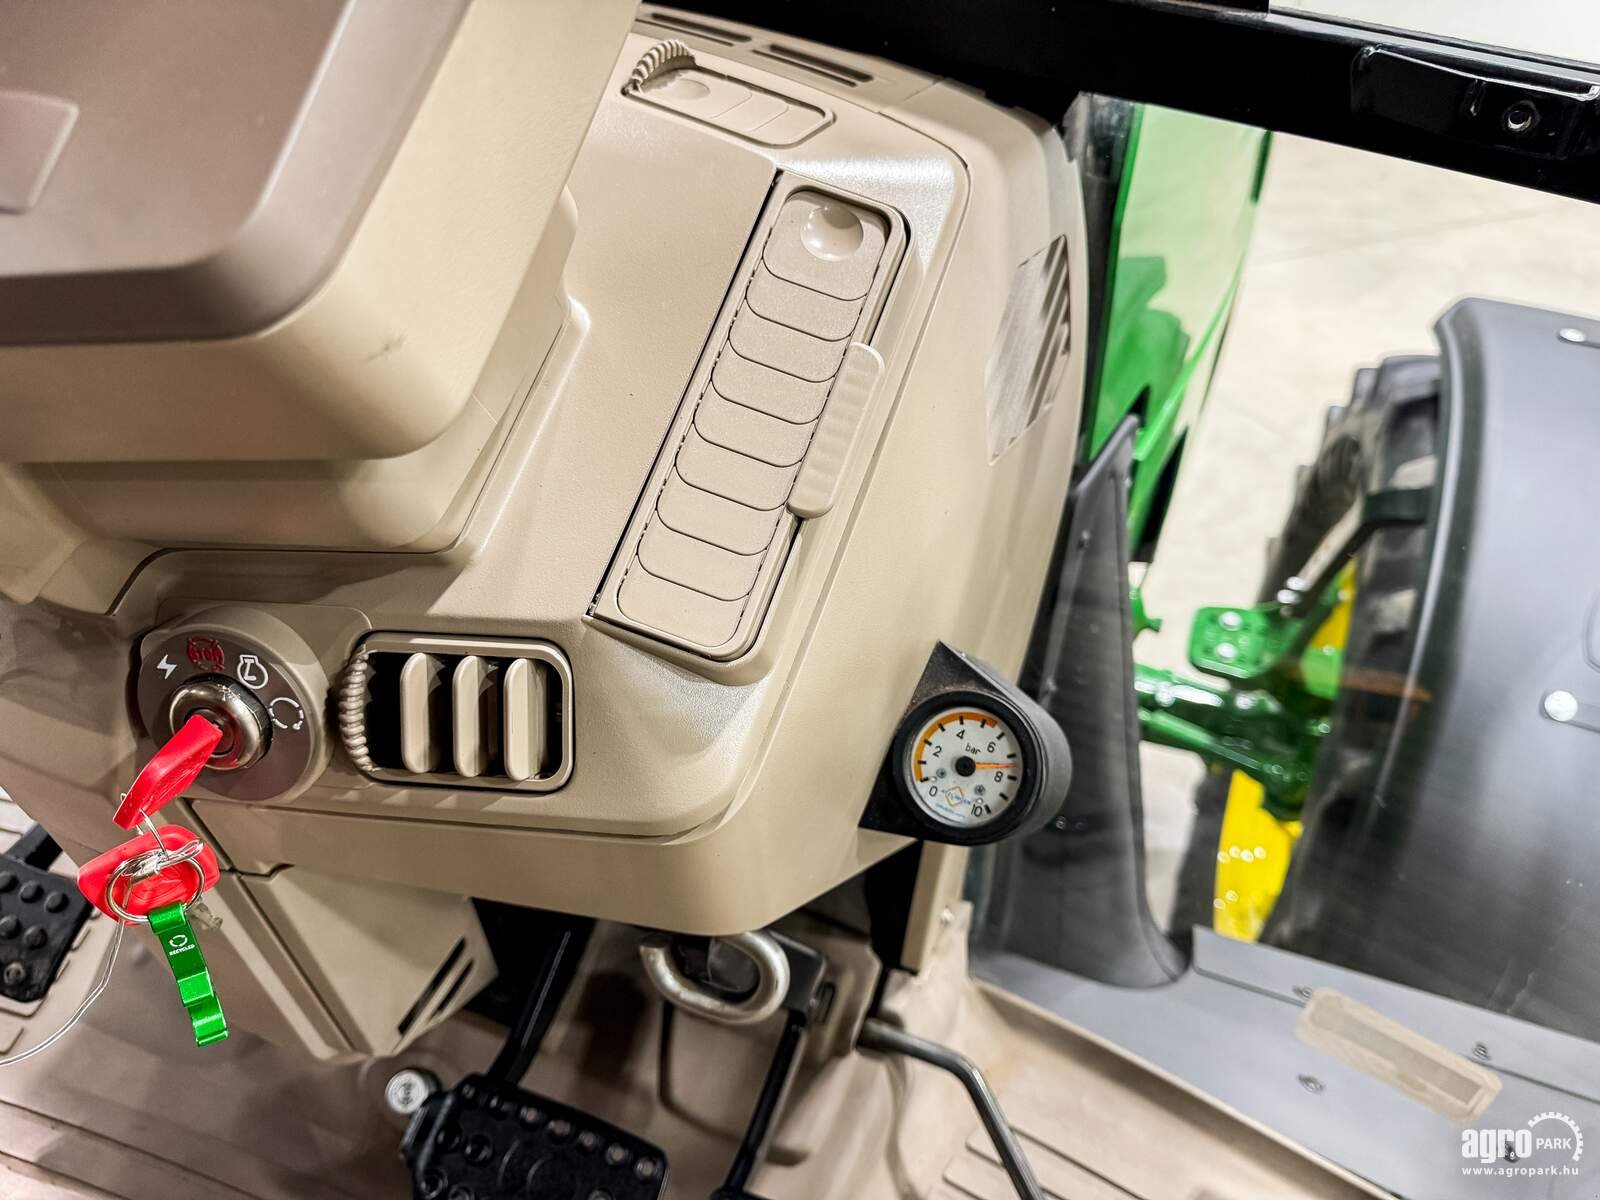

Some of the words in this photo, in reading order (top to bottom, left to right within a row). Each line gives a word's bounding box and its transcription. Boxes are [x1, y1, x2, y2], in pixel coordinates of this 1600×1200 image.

[956, 730, 965, 740] 4
[933, 746, 942, 757] 2
[965, 743, 981, 755] bar
[987, 742, 996, 753] 6
[994, 771, 1003, 783] 8
[929, 785, 938, 797] 0
[971, 804, 983, 817] 10
[169, 943, 195, 956] RECYCLED
